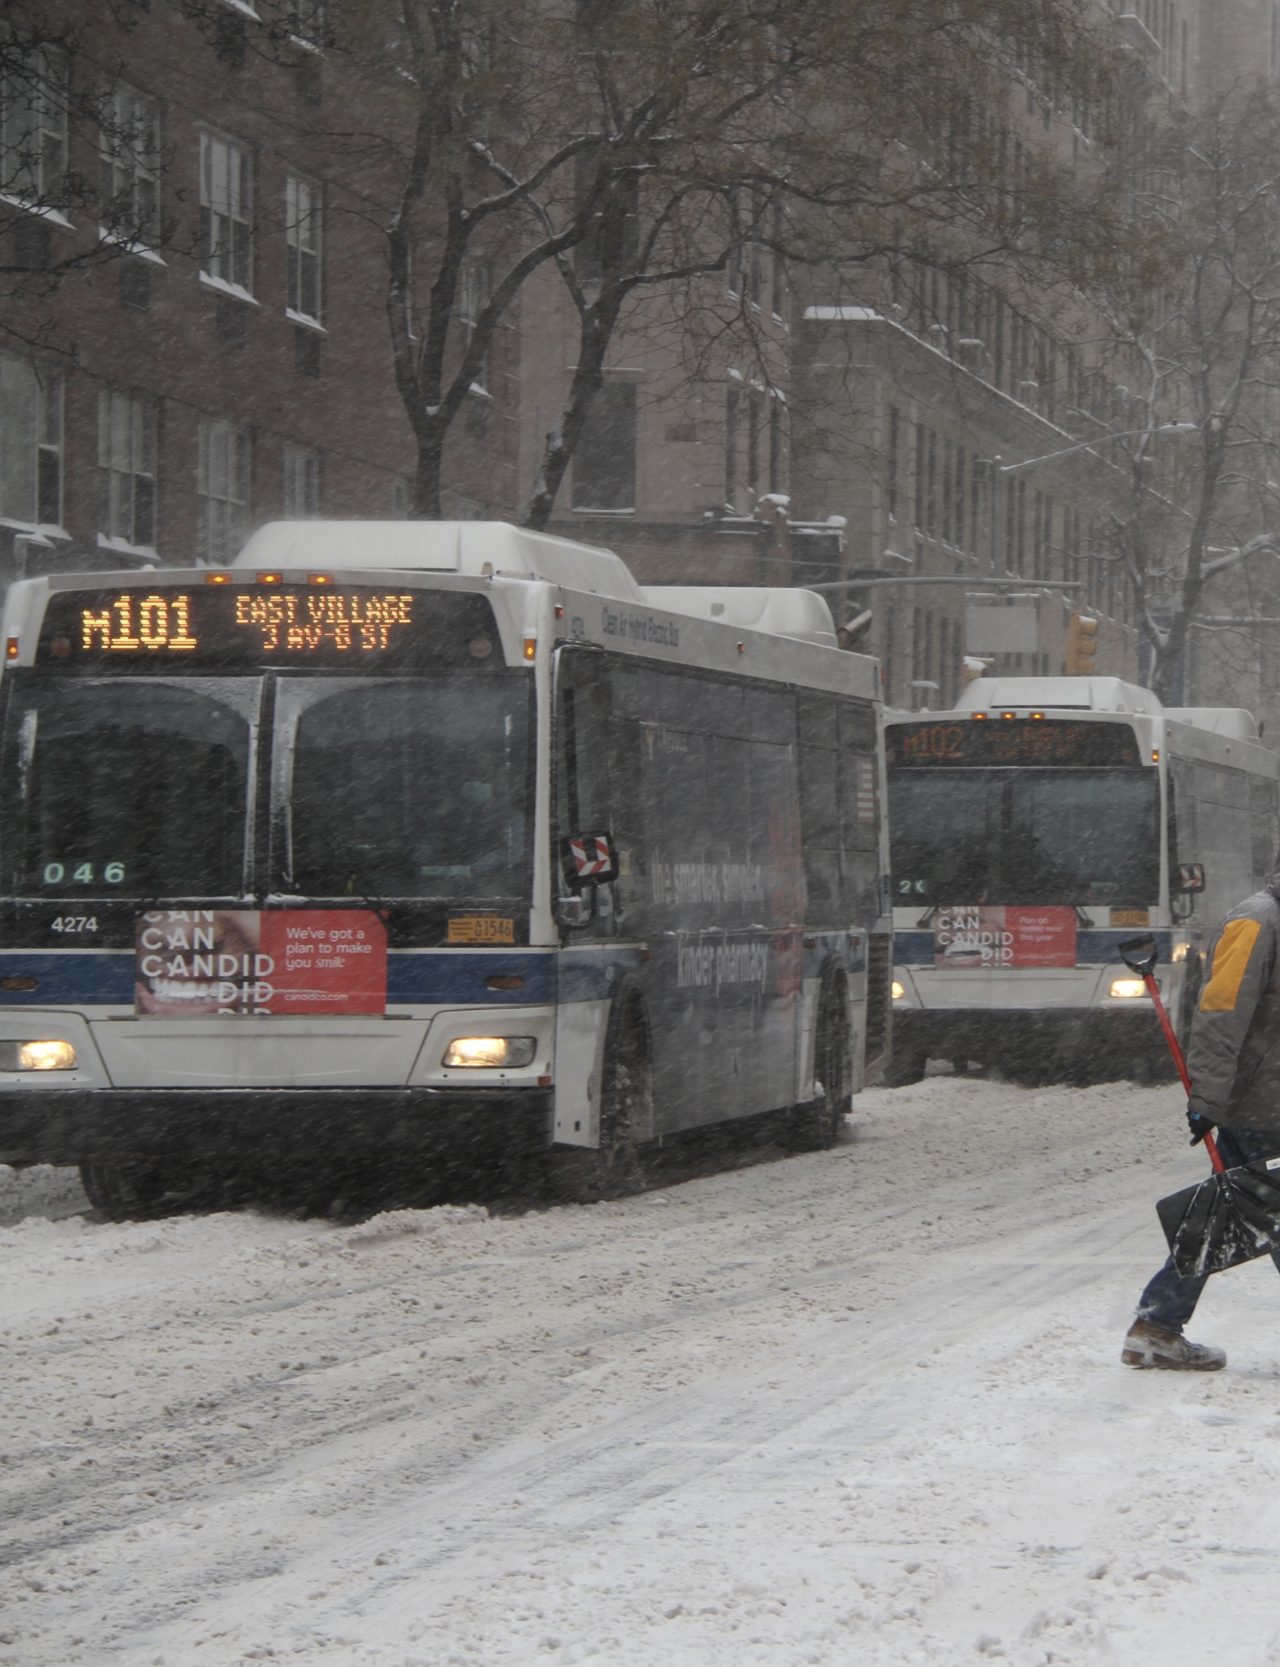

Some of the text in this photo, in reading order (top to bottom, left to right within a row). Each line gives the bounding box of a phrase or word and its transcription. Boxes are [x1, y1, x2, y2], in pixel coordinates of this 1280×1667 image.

[236, 596, 413, 623] EAST VILLAGE
[83, 595, 197, 649] M101
[263, 625, 278, 649] 3
[360, 625, 390, 649] ST
[902, 727, 966, 758] M102
[51, 916, 99, 933] 4274
[938, 916, 979, 930] CAN
[141, 927, 214, 950] CAN
[286, 928, 365, 942] We've got a
[938, 931, 1014, 946] CANDID
[286, 942, 372, 956] plan to make
[981, 947, 1014, 961] DID
[141, 954, 275, 977] CANDID
[286, 956, 346, 971] you smile
[218, 981, 275, 1004] DID
